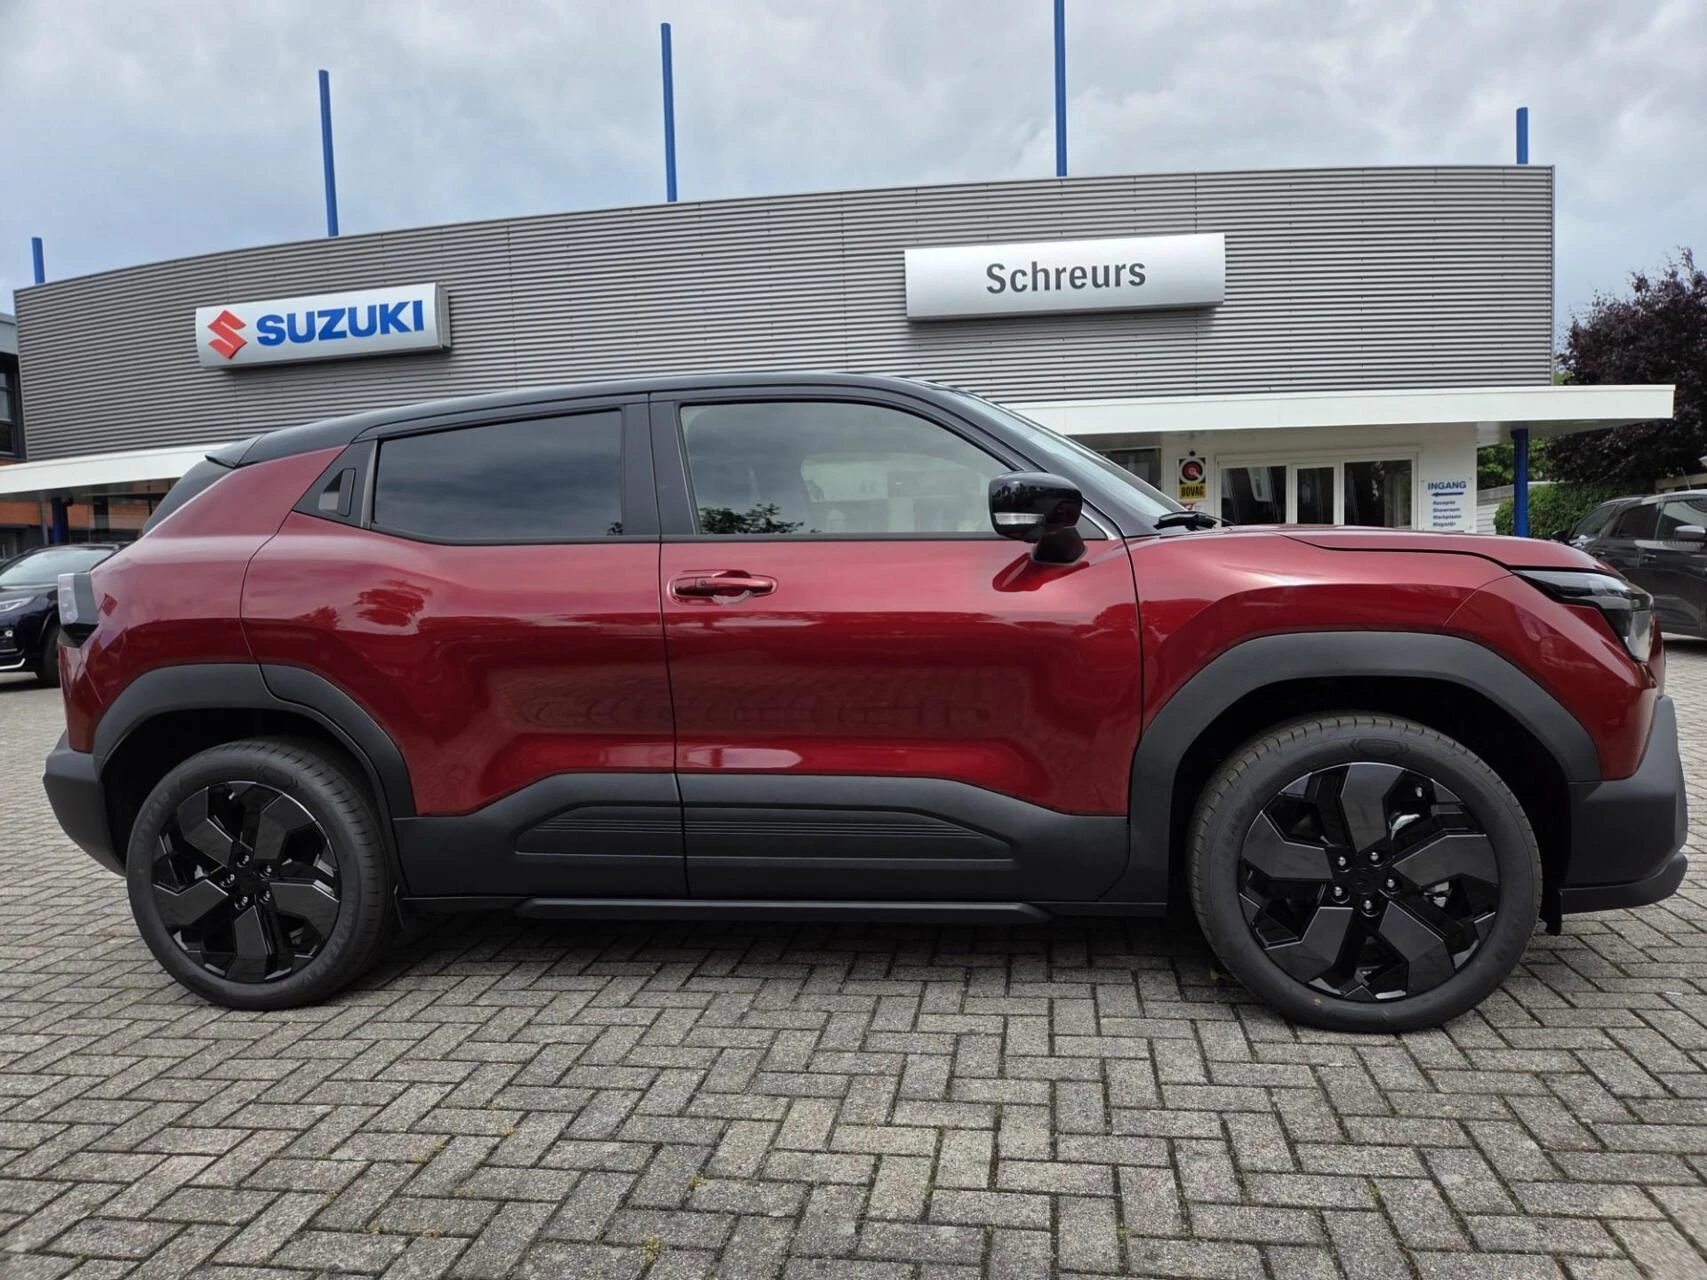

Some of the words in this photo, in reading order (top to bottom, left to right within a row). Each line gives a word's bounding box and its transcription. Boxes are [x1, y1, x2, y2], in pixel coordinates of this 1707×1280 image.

[986, 261, 1146, 294] Schreurs
[256, 300, 424, 346] SUZUKI
[1181, 486, 1204, 497] BOVAG
[1427, 481, 1466, 490] INGANG
